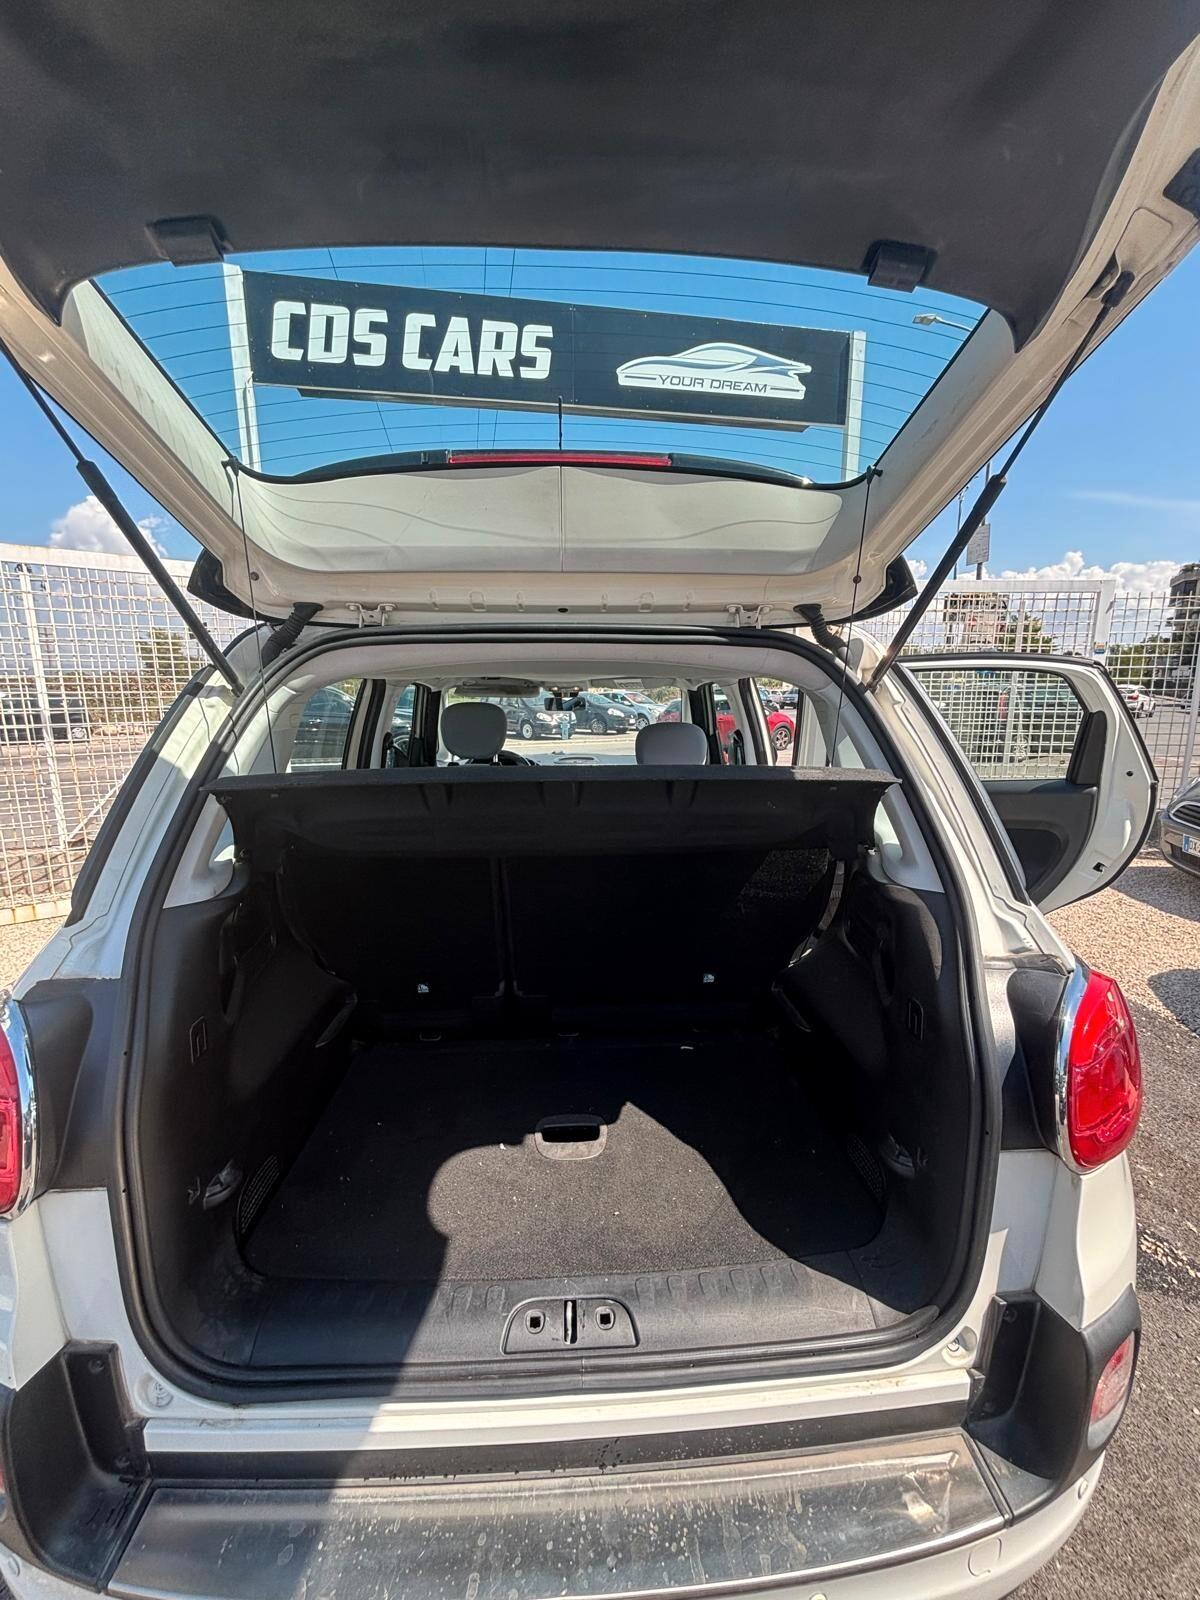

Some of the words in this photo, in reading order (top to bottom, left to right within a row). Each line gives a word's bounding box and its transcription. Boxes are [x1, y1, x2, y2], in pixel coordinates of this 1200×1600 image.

[271, 300, 389, 367] CDS
[402, 312, 554, 380] CARS
[657, 374, 705, 388] YOUR
[709, 378, 768, 394] DREAM
